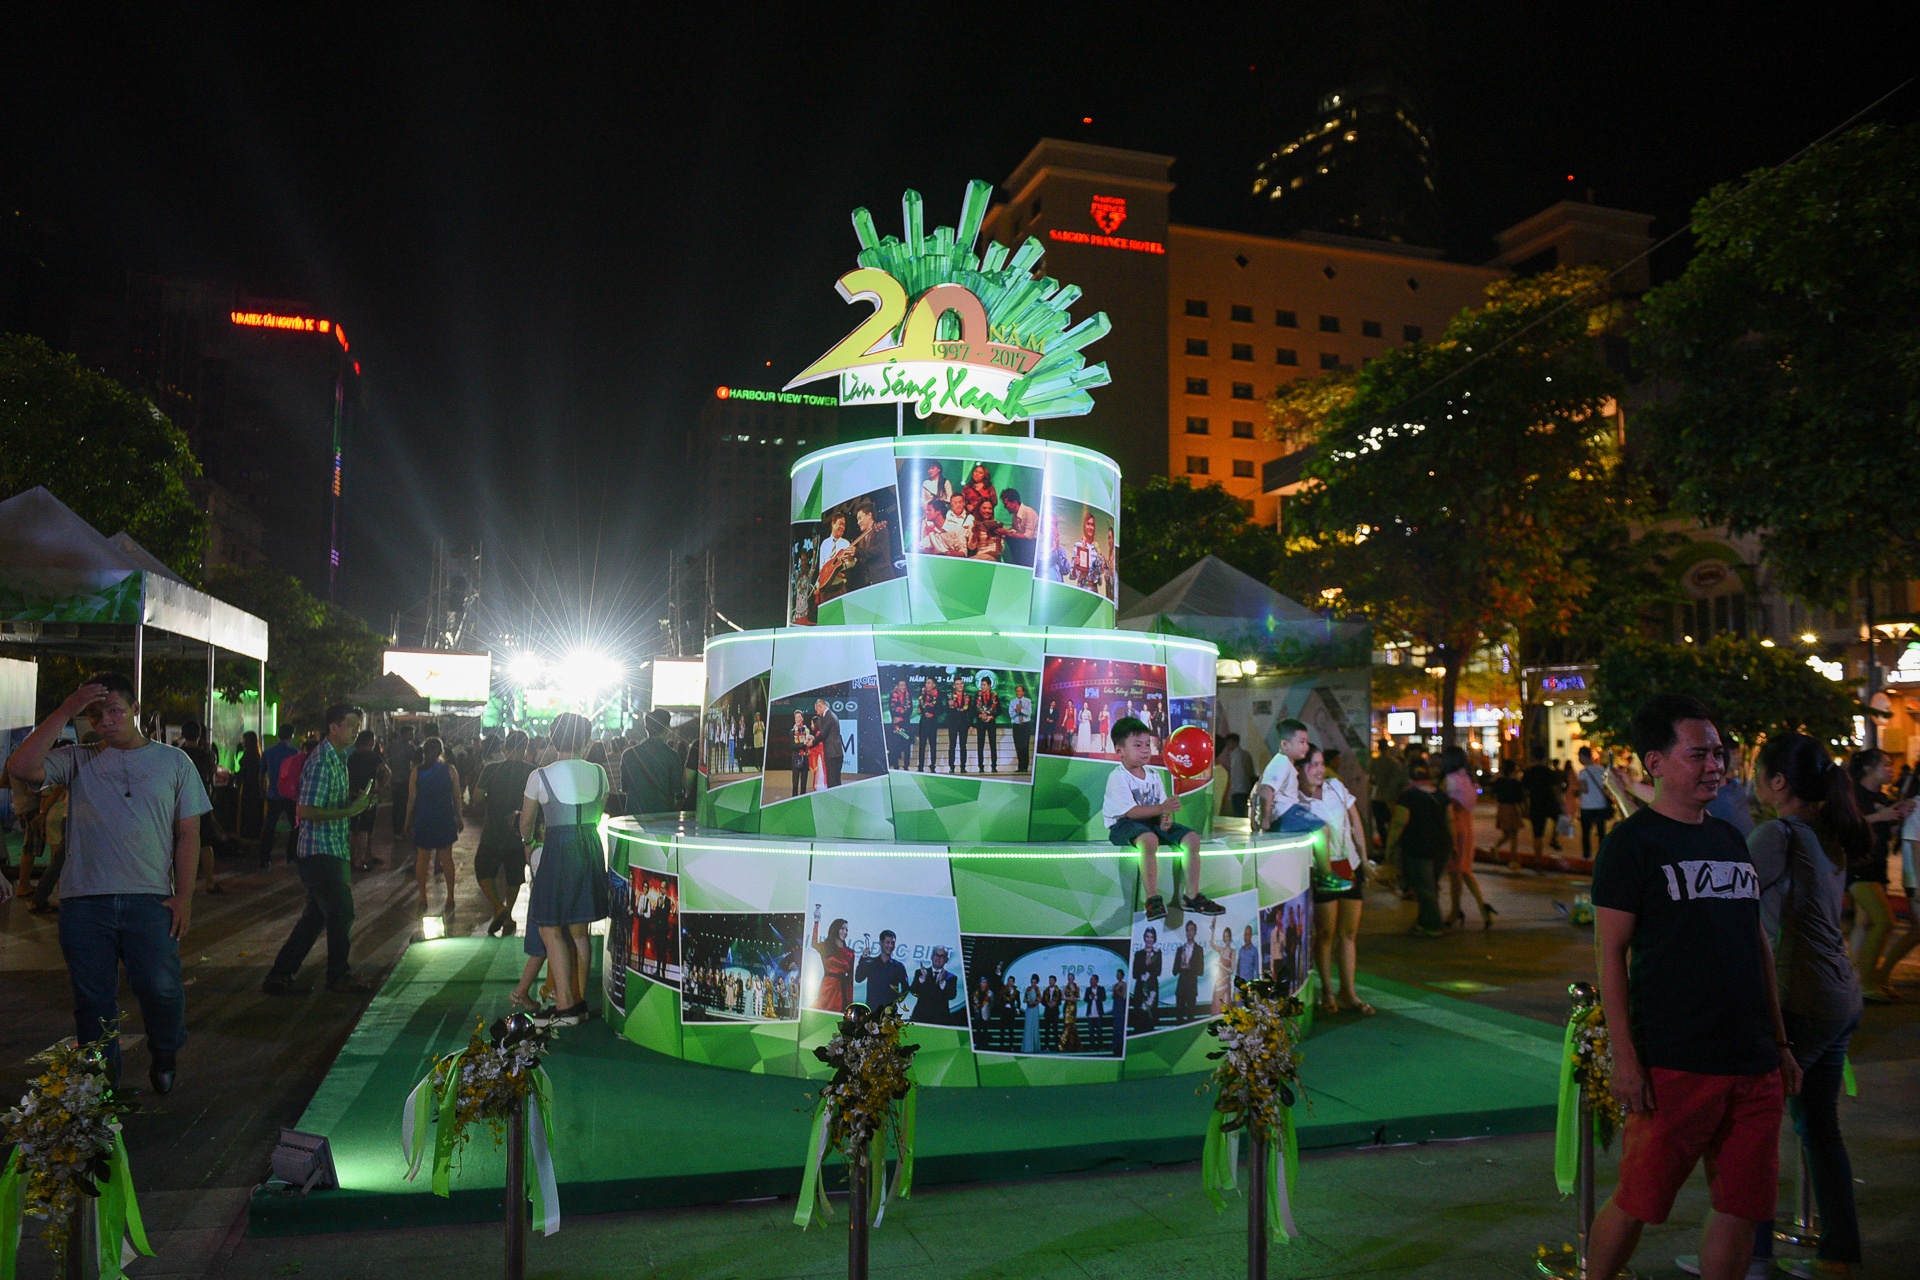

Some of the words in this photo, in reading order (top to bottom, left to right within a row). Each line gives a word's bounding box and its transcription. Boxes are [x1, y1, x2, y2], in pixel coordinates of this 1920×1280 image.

[1050, 229, 1089, 243] SAIGON
[1091, 235, 1128, 249] PRINCE
[1130, 240, 1165, 255] HOTEL
[782, 267, 990, 391] 20
[989, 323, 1046, 354] NĂM
[932, 343, 970, 361] 1997
[991, 347, 1027, 373] 2017
[729, 389, 776, 402] HARBOUR
[777, 393, 801, 404] VIEW
[803, 395, 838, 407] TOWER
[939, 366, 1031, 420] Xanh
[1061, 963, 1085, 976] TOP
